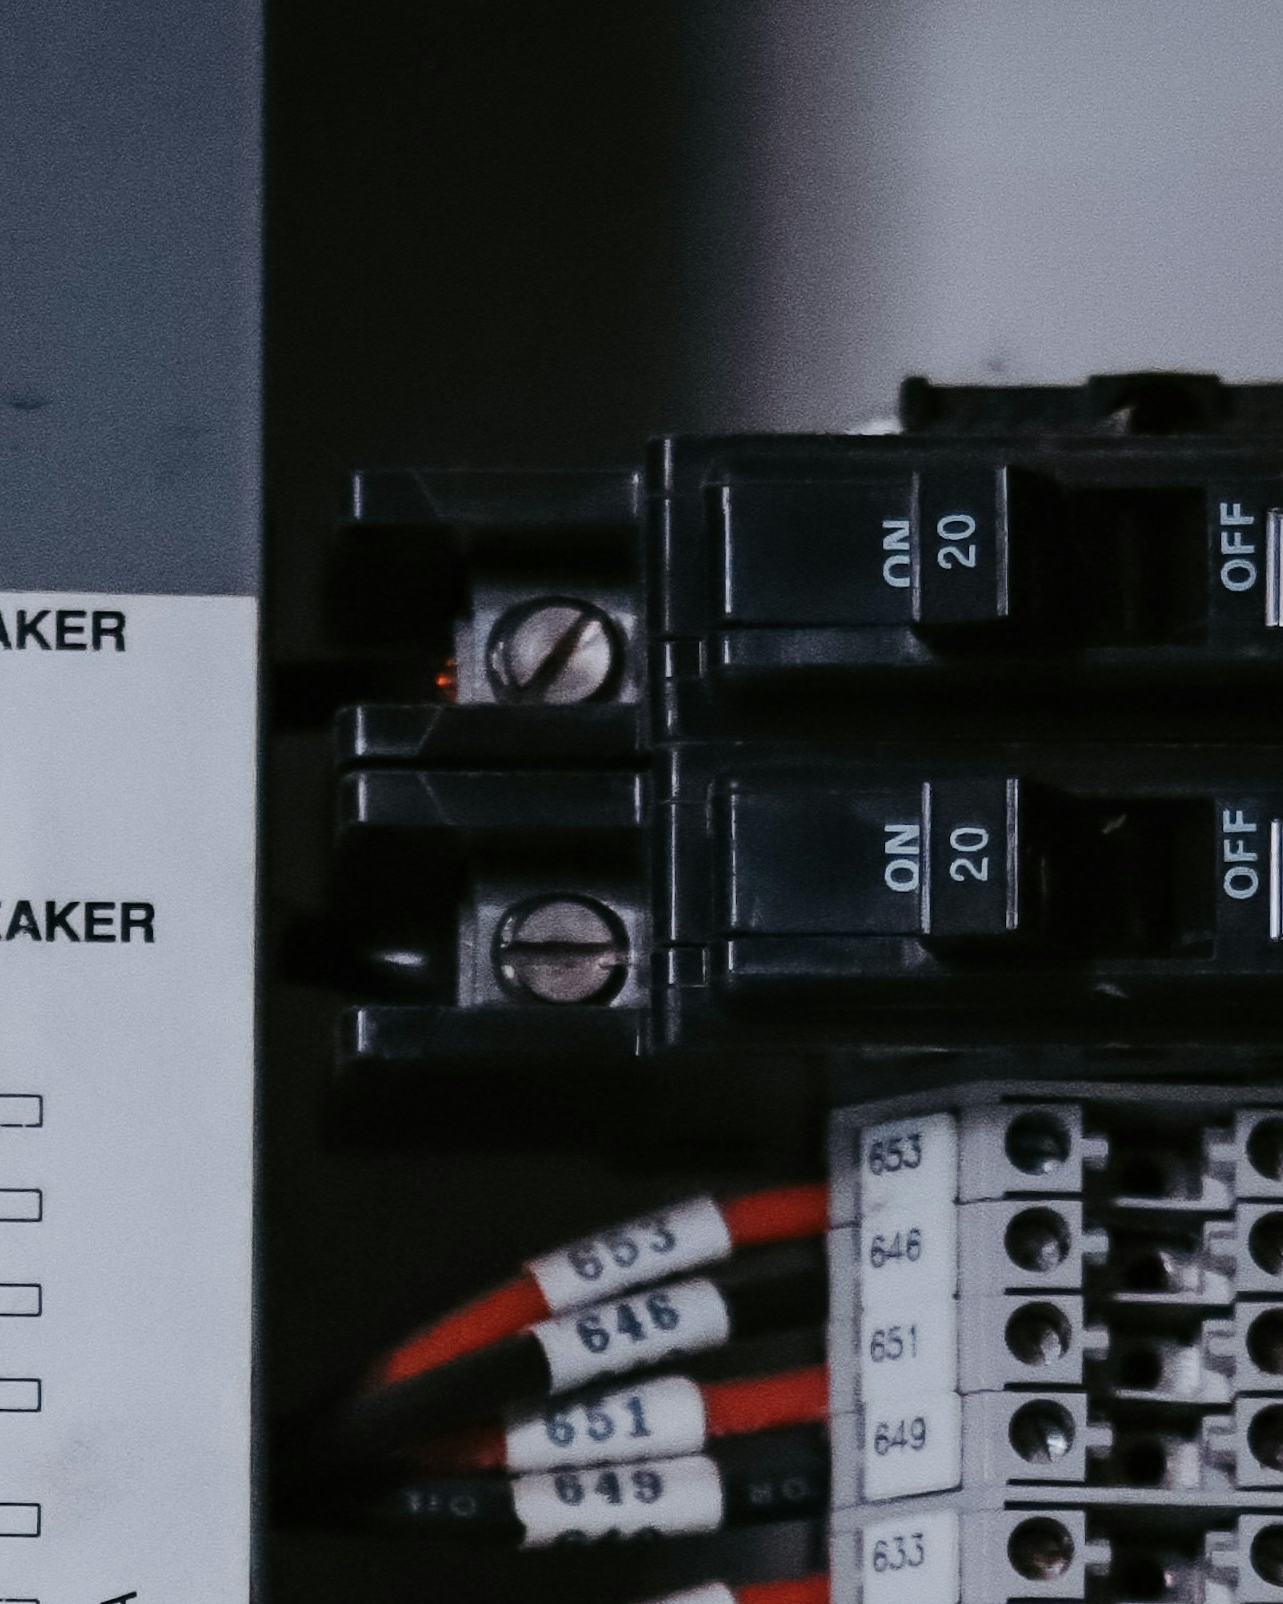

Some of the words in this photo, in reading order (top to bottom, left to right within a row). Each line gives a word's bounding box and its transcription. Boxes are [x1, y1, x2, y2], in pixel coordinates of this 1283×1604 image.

[938, 513, 976, 569] 20
[1221, 502, 1256, 592] OFF
[885, 824, 919, 893] ON
[950, 827, 989, 882] 20
[1223, 808, 1258, 900] OFF
[869, 1132, 923, 1176] 653
[870, 1228, 922, 1269] 646
[870, 1325, 920, 1363] 651
[544, 1398, 651, 1448] 651
[873, 1417, 926, 1456] 649
[872, 1533, 925, 1573] 633
